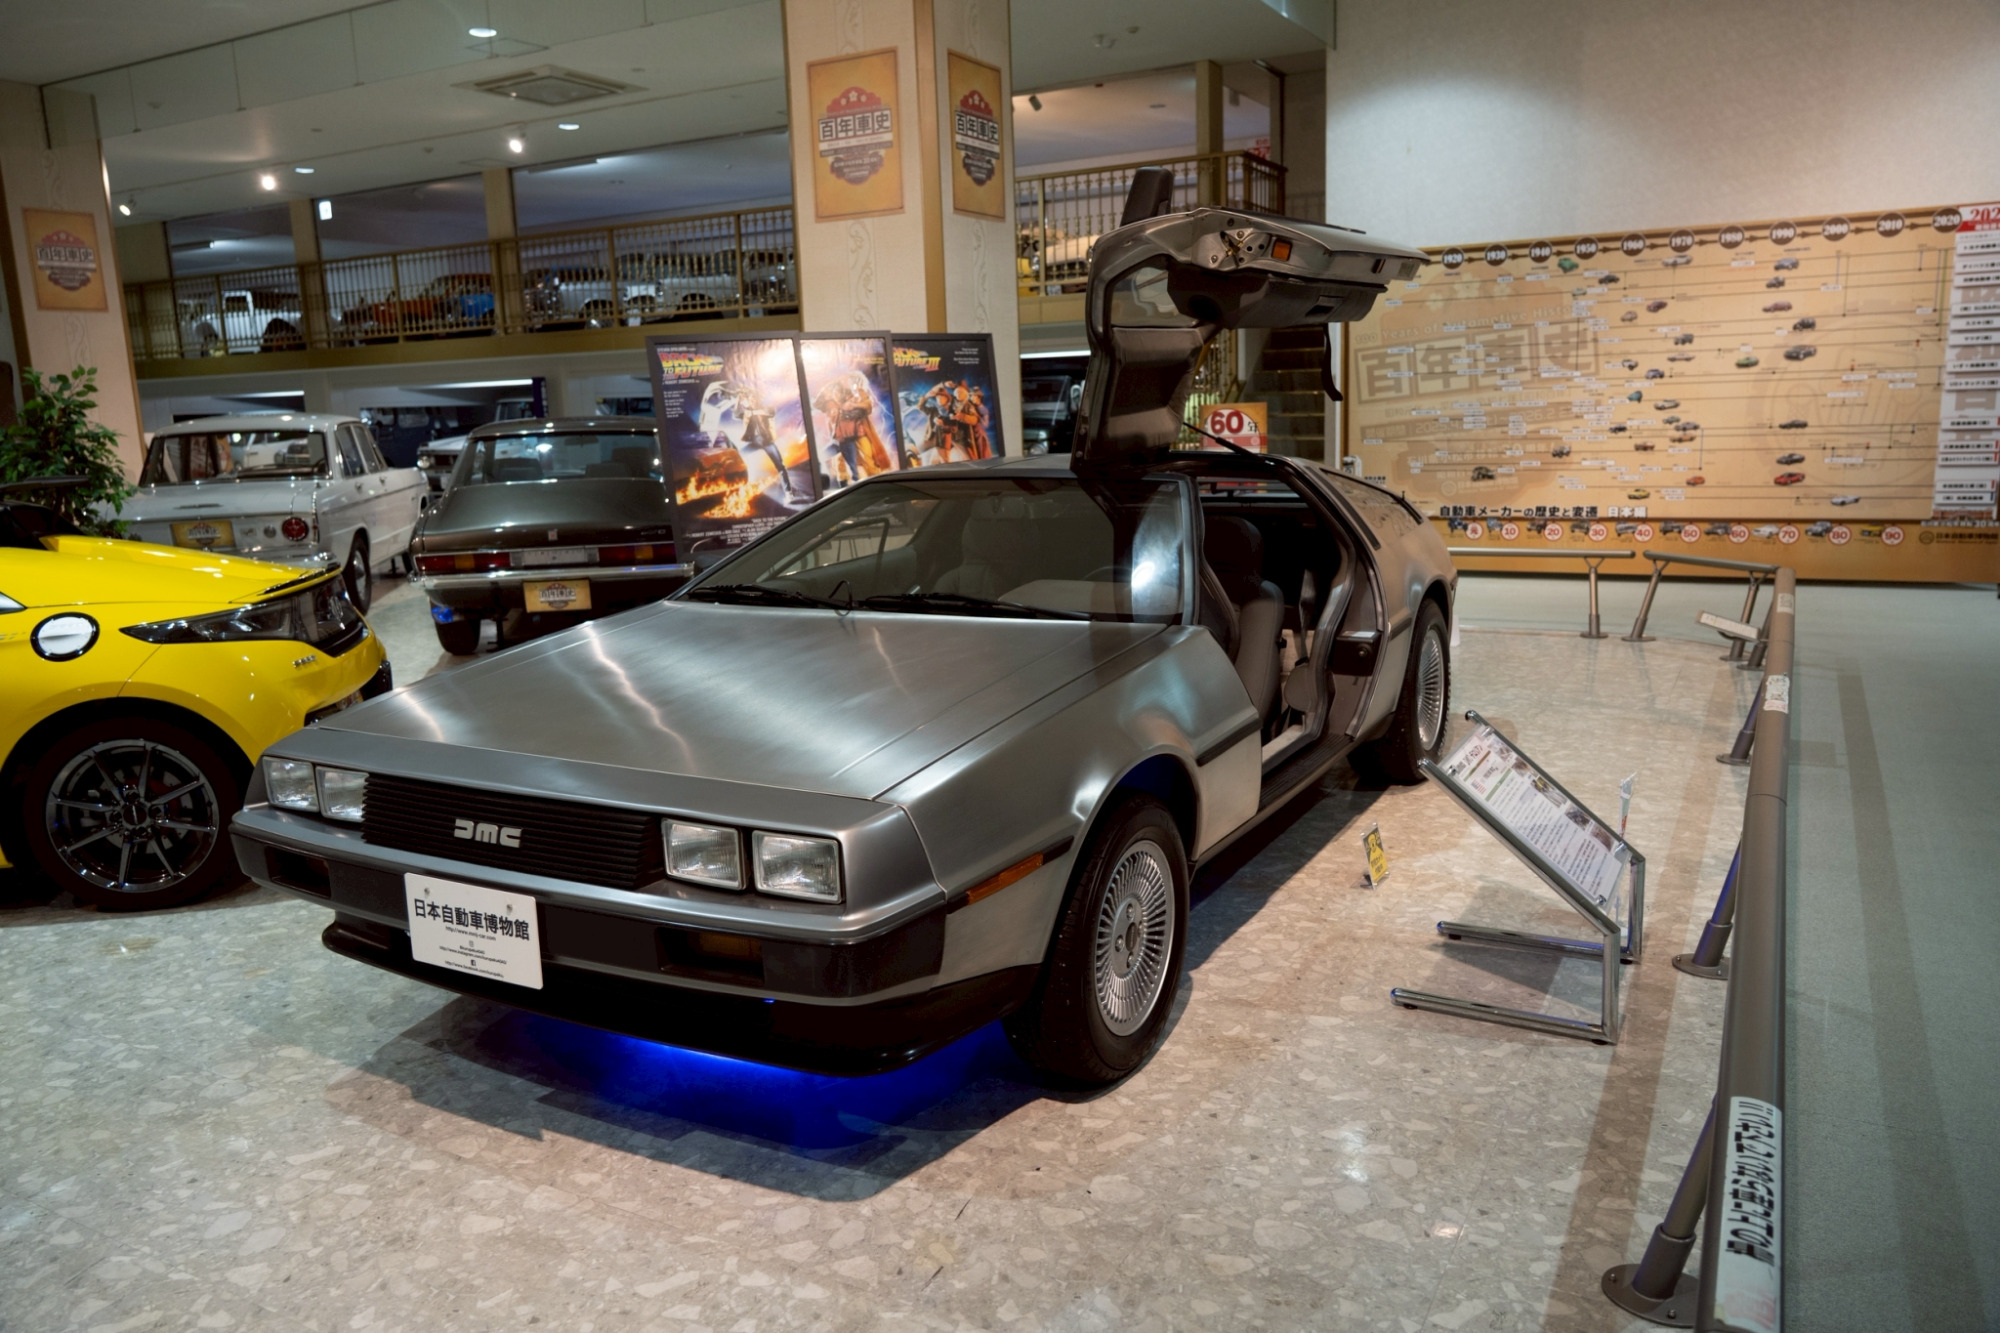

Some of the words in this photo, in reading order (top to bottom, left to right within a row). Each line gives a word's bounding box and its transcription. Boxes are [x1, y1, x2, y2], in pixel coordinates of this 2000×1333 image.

[820, 111, 890, 140] 百年車史
[956, 113, 999, 142] 百年車史
[1443, 252, 1464, 264] 1920
[1486, 249, 1506, 261] 1930
[1530, 246, 1551, 258] 1940
[1576, 243, 1597, 254] 1950
[1622, 240, 1645, 251] 1960
[1671, 235, 1694, 247] 1970
[1720, 232, 1743, 243] 1980
[1771, 227, 1795, 239] 1990
[1823, 223, 1849, 235] 2000
[1877, 218, 1903, 231] 2010
[1934, 214, 1961, 227] 2020
[1533, 305, 1573, 319] Histo
[659, 352, 712, 367] BACK
[674, 364, 724, 379] FUTURE
[1361, 324, 1592, 398] 百年車史
[1211, 410, 1244, 435] 60
[1439, 505, 1599, 518] 自動車メーカーの歴史と変遷
[1504, 527, 1516, 536] 10
[1547, 528, 1560, 536] 20
[1592, 528, 1604, 537] 30
[1637, 529, 1651, 537] 40
[1781, 530, 1796, 539] 70
[1832, 530, 1848, 540] 80
[1885, 531, 1901, 541] 90
[453, 818, 524, 848] DMC
[413, 897, 530, 941] 日本自動車博物館
